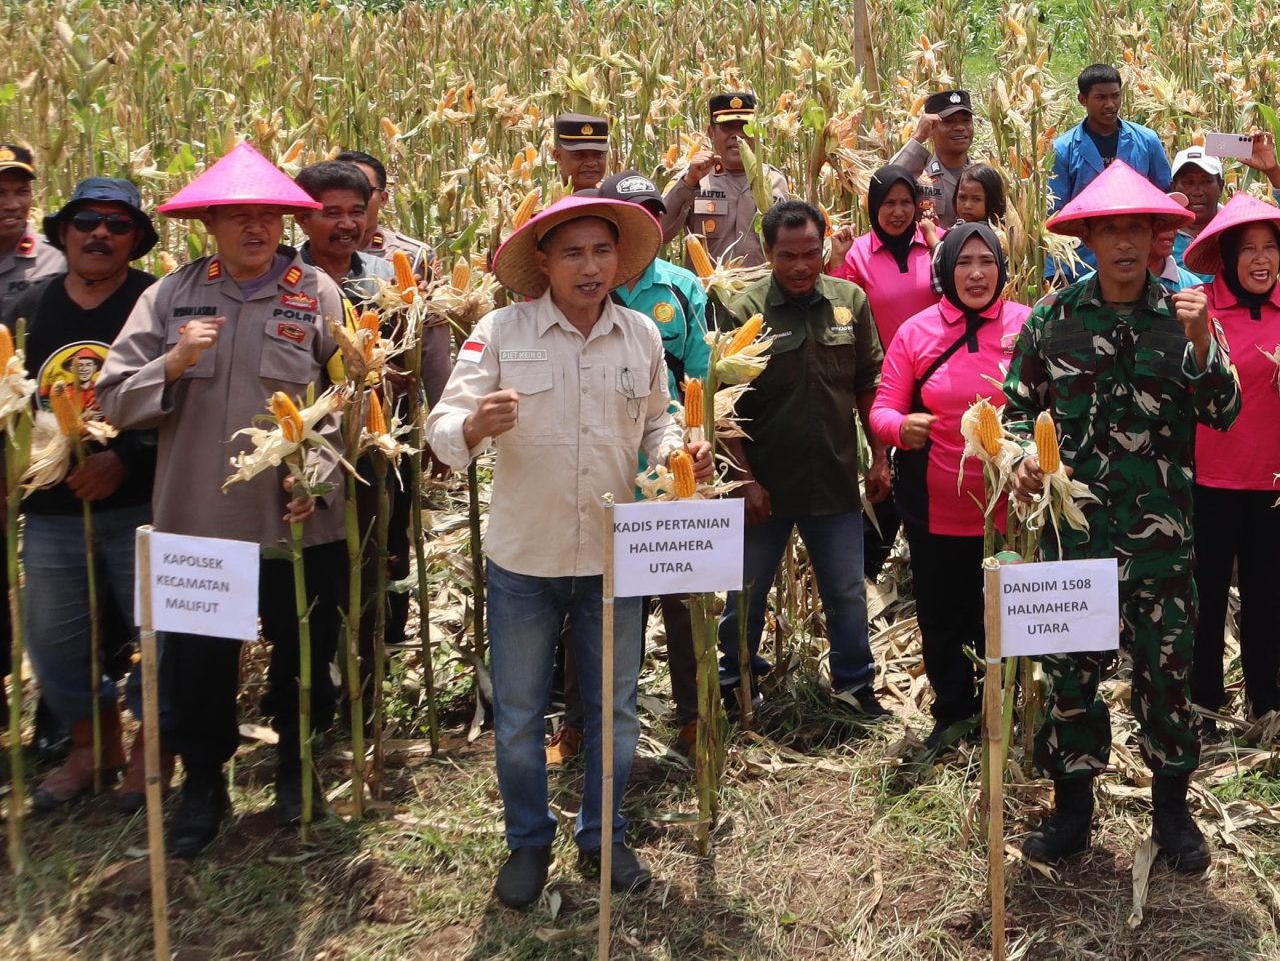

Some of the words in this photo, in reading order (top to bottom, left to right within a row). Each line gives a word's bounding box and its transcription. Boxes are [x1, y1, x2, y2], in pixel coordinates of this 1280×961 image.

[273, 308, 317, 324] POLRI
[613, 520, 652, 533] KADIS
[656, 517, 731, 531] PERTANIAN
[629, 539, 714, 554] HALMAHERA
[163, 552, 224, 570] KAPOLSEK
[649, 562, 694, 574] UTARA
[156, 575, 230, 593] KECAMATAN
[1003, 580, 1058, 594] DANDIM
[1061, 578, 1092, 591] 1508
[165, 597, 220, 614] MALIFUT
[1007, 600, 1089, 616] HALMAHERA
[1027, 622, 1070, 635] UTARA
